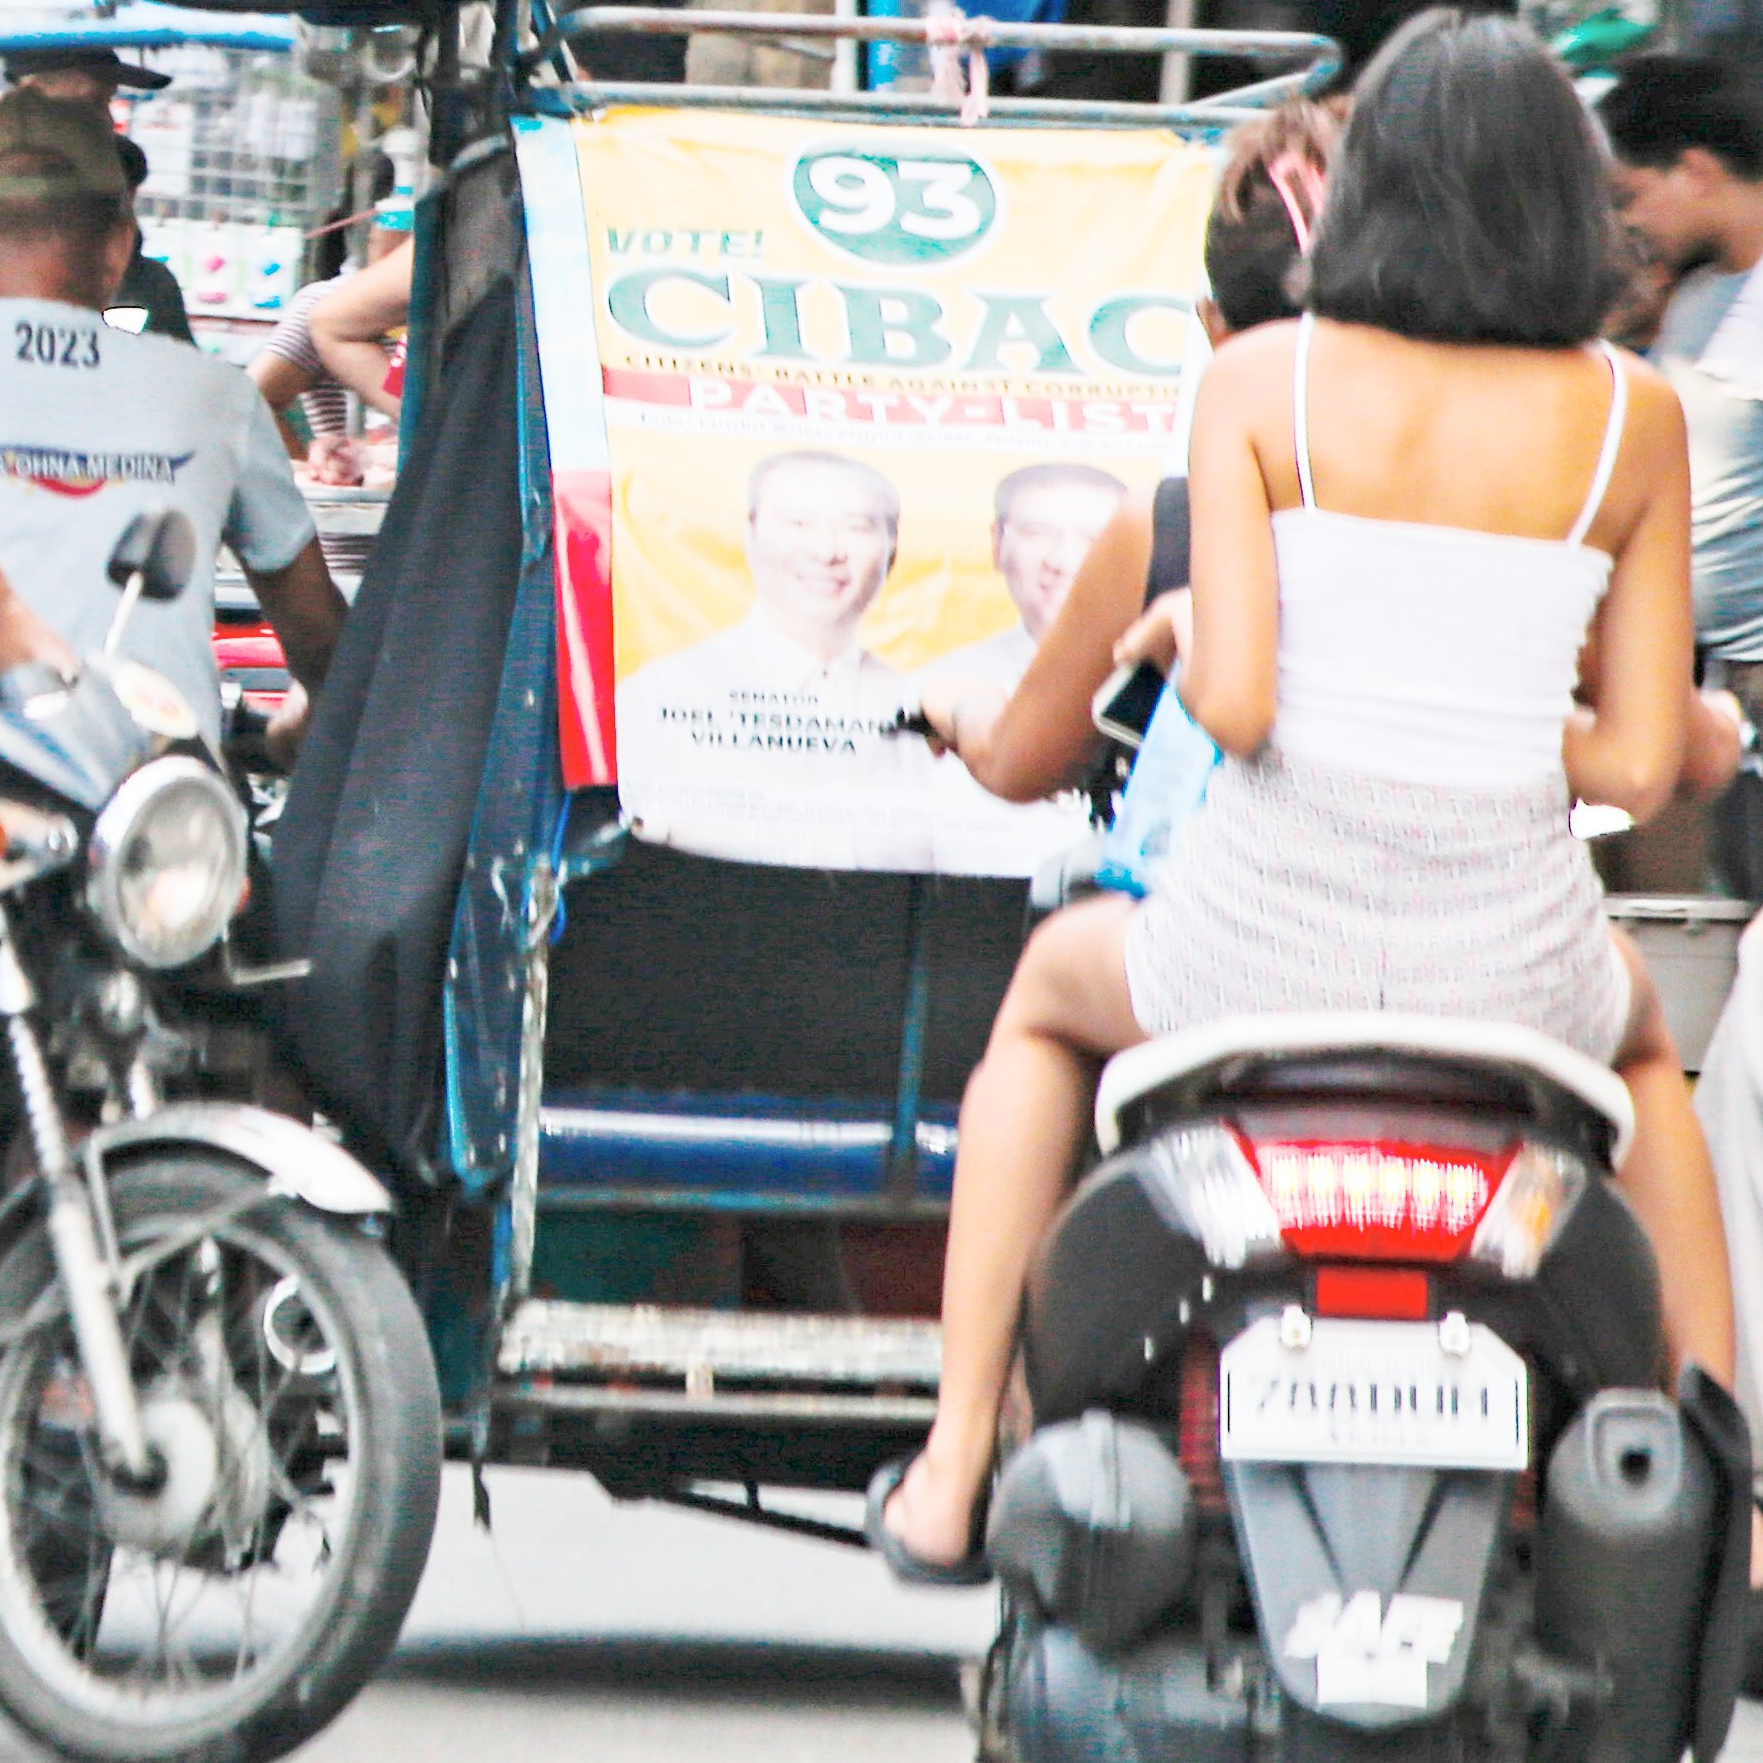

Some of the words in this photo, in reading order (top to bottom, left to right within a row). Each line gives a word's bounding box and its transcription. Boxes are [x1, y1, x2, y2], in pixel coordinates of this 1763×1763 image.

[808, 155, 981, 241] 93
[606, 227, 766, 258] VOTE!
[607, 266, 1191, 377] CIBAC
[14, 318, 101, 369] 2023
[775, 368, 877, 386] BATTLE
[888, 377, 1011, 393] AGAINST
[688, 376, 1177, 434] PARTY-LIST
[728, 689, 819, 705] SENATOR
[658, 706, 715, 725] JOEL
[689, 732, 857, 756] VILLANUEVA
